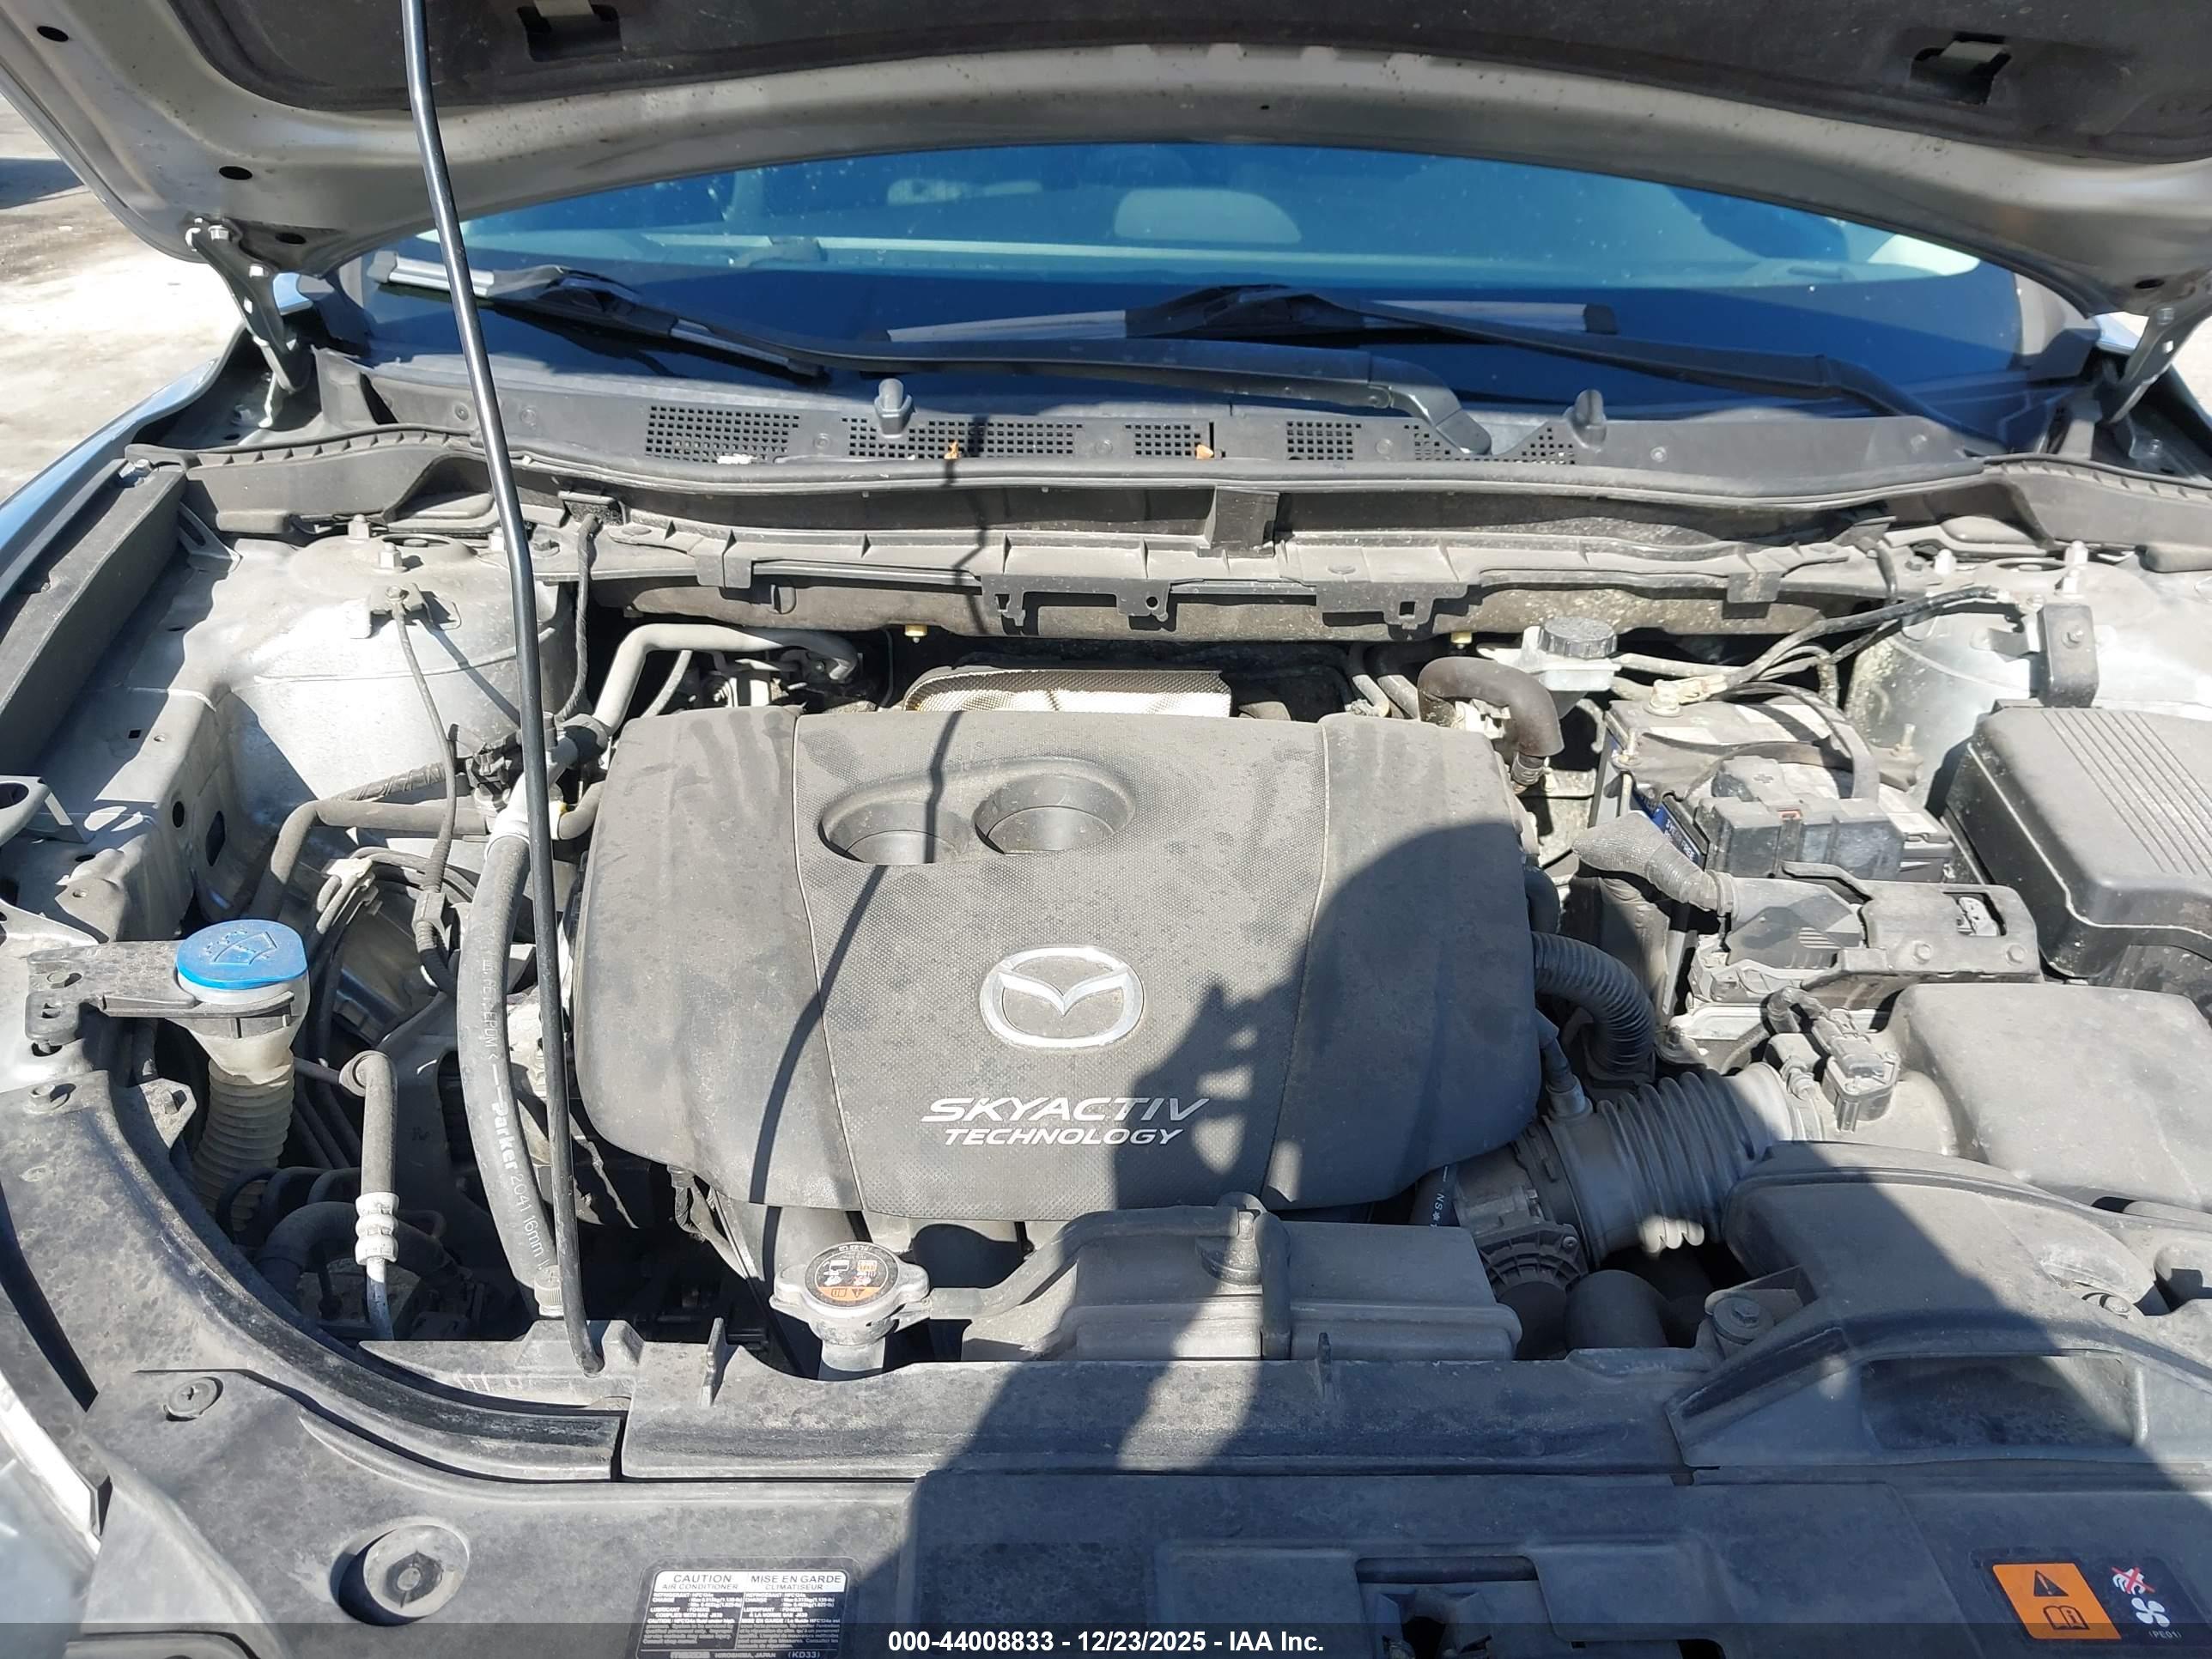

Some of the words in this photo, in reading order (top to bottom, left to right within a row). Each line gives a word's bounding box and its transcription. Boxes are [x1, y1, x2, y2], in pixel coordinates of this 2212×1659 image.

[921, 1097, 1210, 1122] SKYACTIV
[944, 1127, 1184, 1146] TECHNOLOGY
[492, 1102, 518, 1170] Parker
[511, 1173, 532, 1213] 2041
[523, 1215, 545, 1258] 16mm
[673, 1574, 732, 1583] CAUTION
[750, 1575, 778, 1583] MISE
[781, 1575, 798, 1583] EN
[799, 1575, 842, 1583] GARDE
